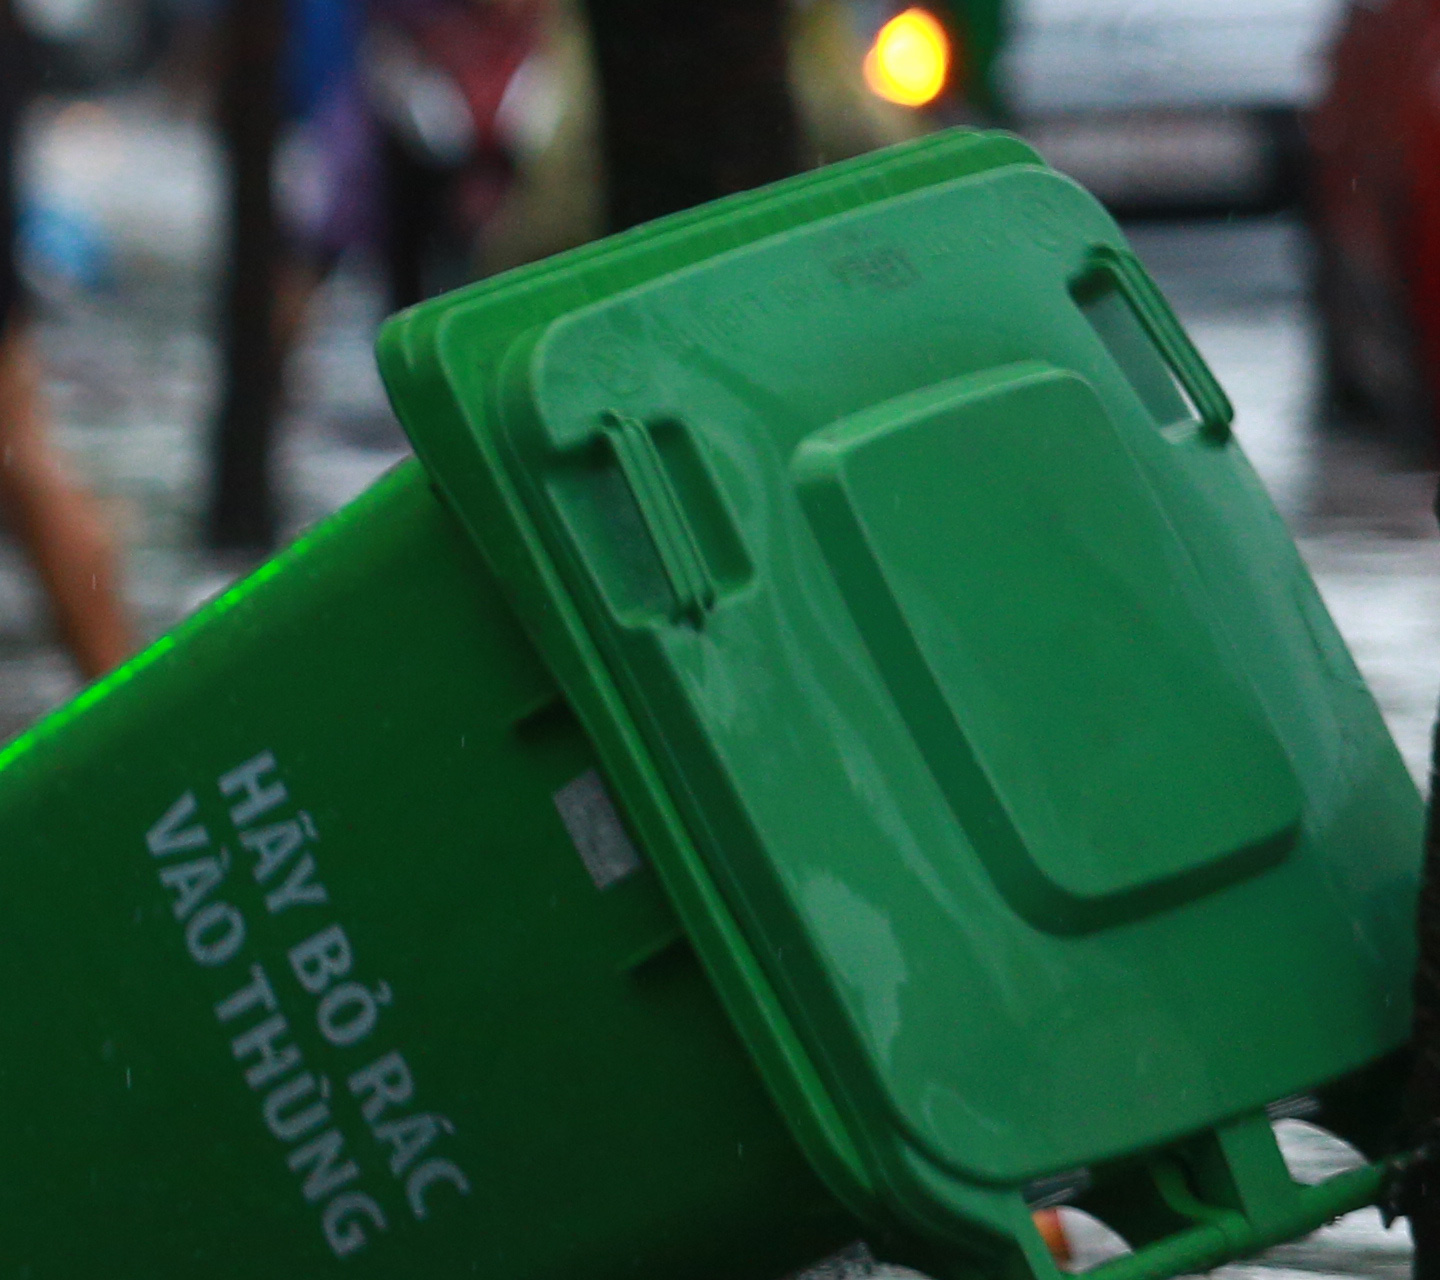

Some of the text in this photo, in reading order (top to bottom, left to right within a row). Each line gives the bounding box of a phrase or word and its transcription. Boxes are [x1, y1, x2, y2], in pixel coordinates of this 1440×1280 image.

[145, 789, 388, 1259] VÀO THÙNG
[218, 748, 471, 1222] HÃY BỎ RÁC
